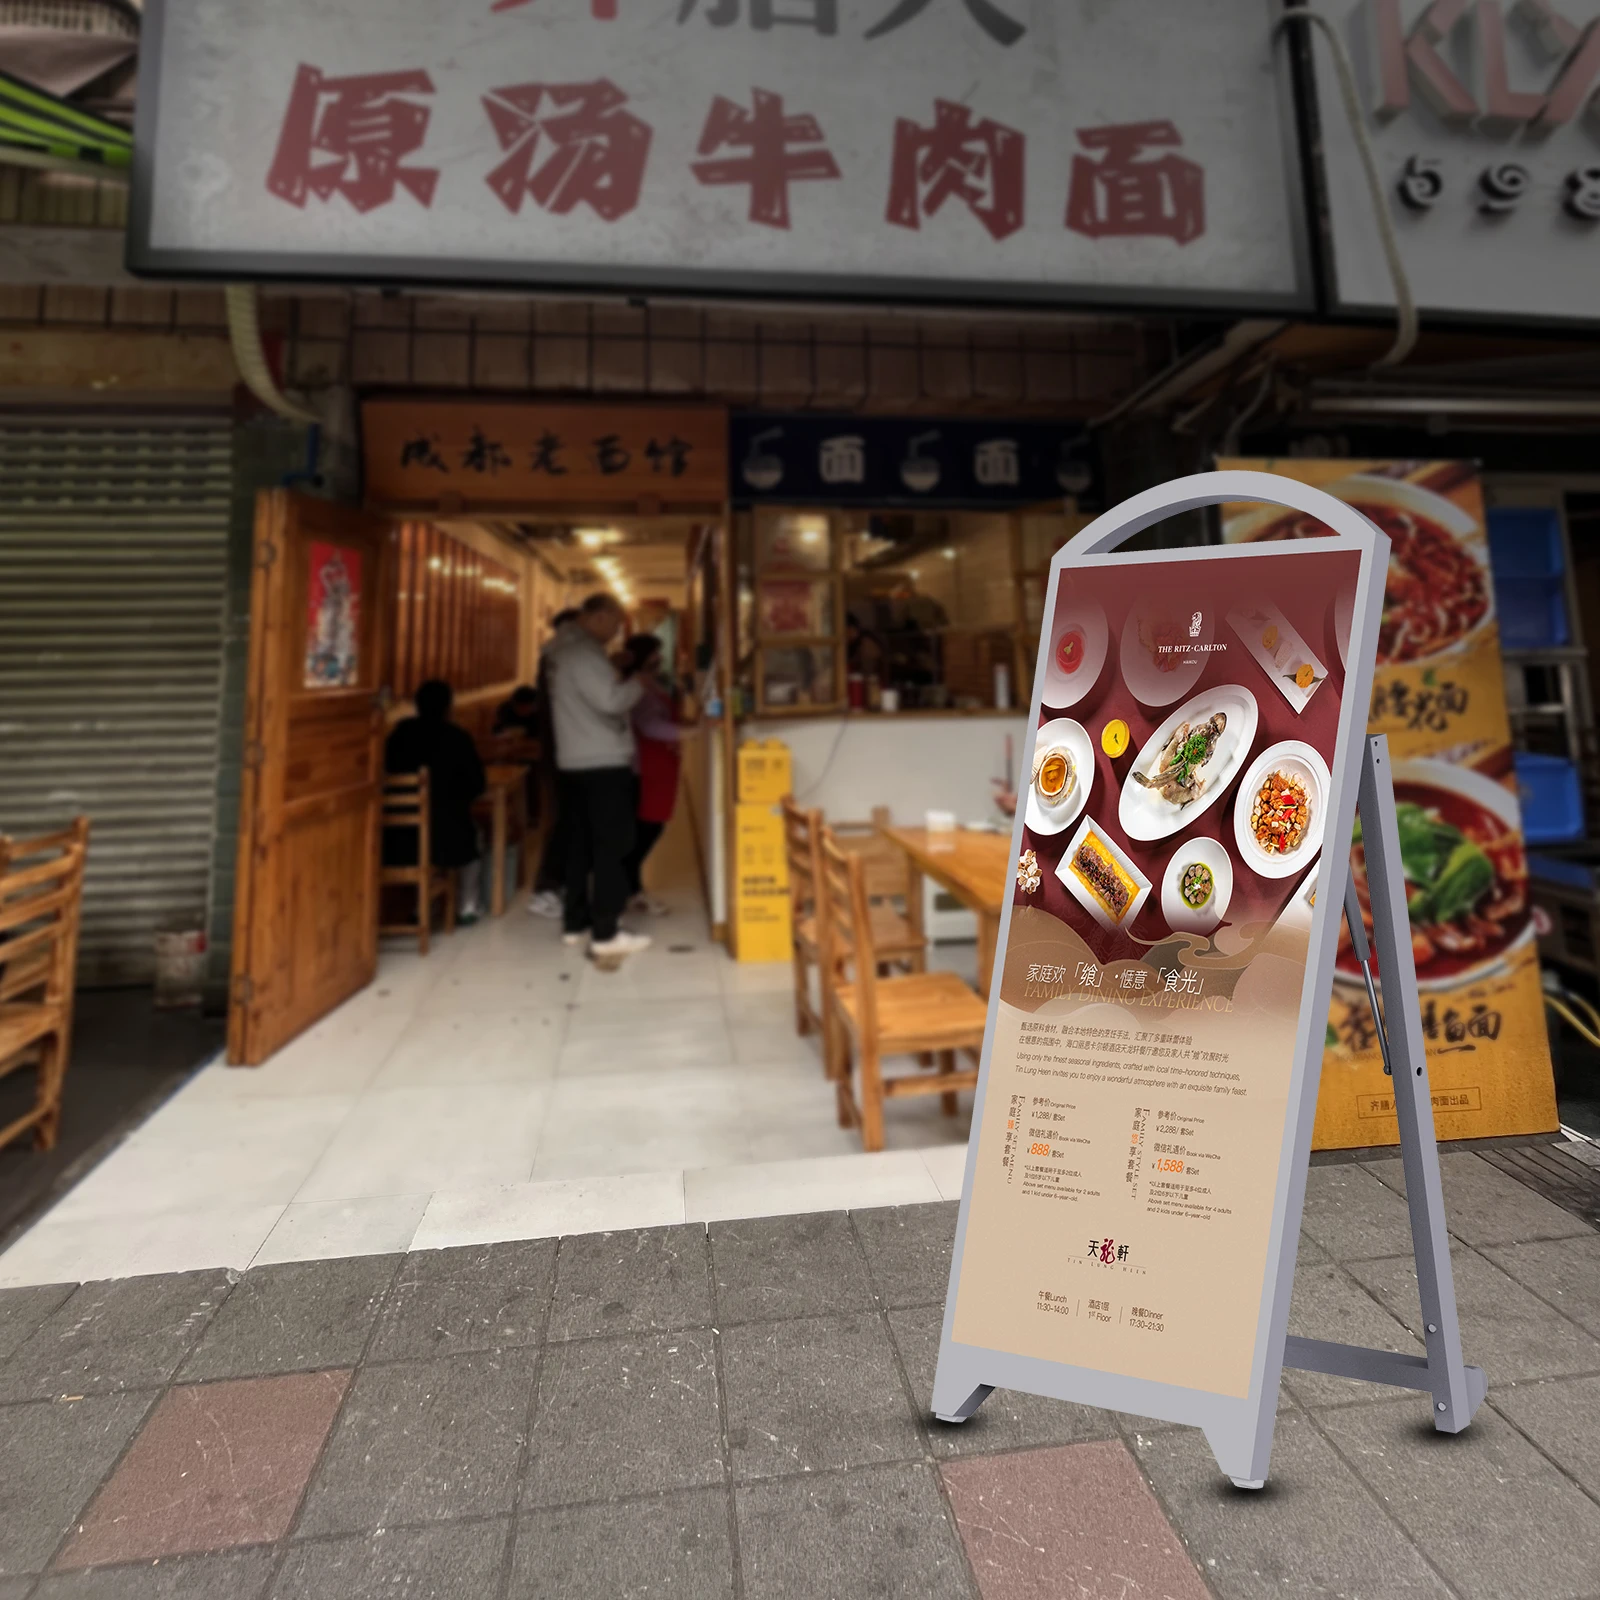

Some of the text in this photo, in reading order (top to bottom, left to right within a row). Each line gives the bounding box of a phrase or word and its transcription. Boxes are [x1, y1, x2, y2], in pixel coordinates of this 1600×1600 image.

[265, 62, 1206, 246] 原汤牛肉面
[819, 436, 865, 484] 面
[974, 440, 1018, 486] 面
[1024, 982, 1234, 1013] FAMILY DINING EXPERIENCE
[1016, 1052, 1031, 1061] Using
[1053, 1055, 1067, 1063] finest
[1068, 1057, 1091, 1066] seasonal
[1092, 1059, 1121, 1070] ingredients,
[1123, 1062, 1142, 1071] crafted
[1143, 1064, 1155, 1072] with
[1156, 1065, 1169, 1074] local
[1024, 1066, 1037, 1076] Lung
[1087, 1073, 1101, 1082] enjoy
[1107, 1076, 1133, 1084] wonderful
[1134, 1077, 1165, 1088] atmosphere
[1167, 1080, 1178, 1089] with
[1188, 1083, 1213, 1093] exquisite
[1214, 1085, 1231, 1096] family
[1015, 1096, 1026, 1132] FAMILY
[1032, 1097, 1050, 1107] 参考价
[1158, 1110, 1177, 1121] 参考价
[1138, 1108, 1150, 1147] FAMILY
[1184, 1203, 1204, 1211] available
[1096, 1312, 1111, 1322] Floor
